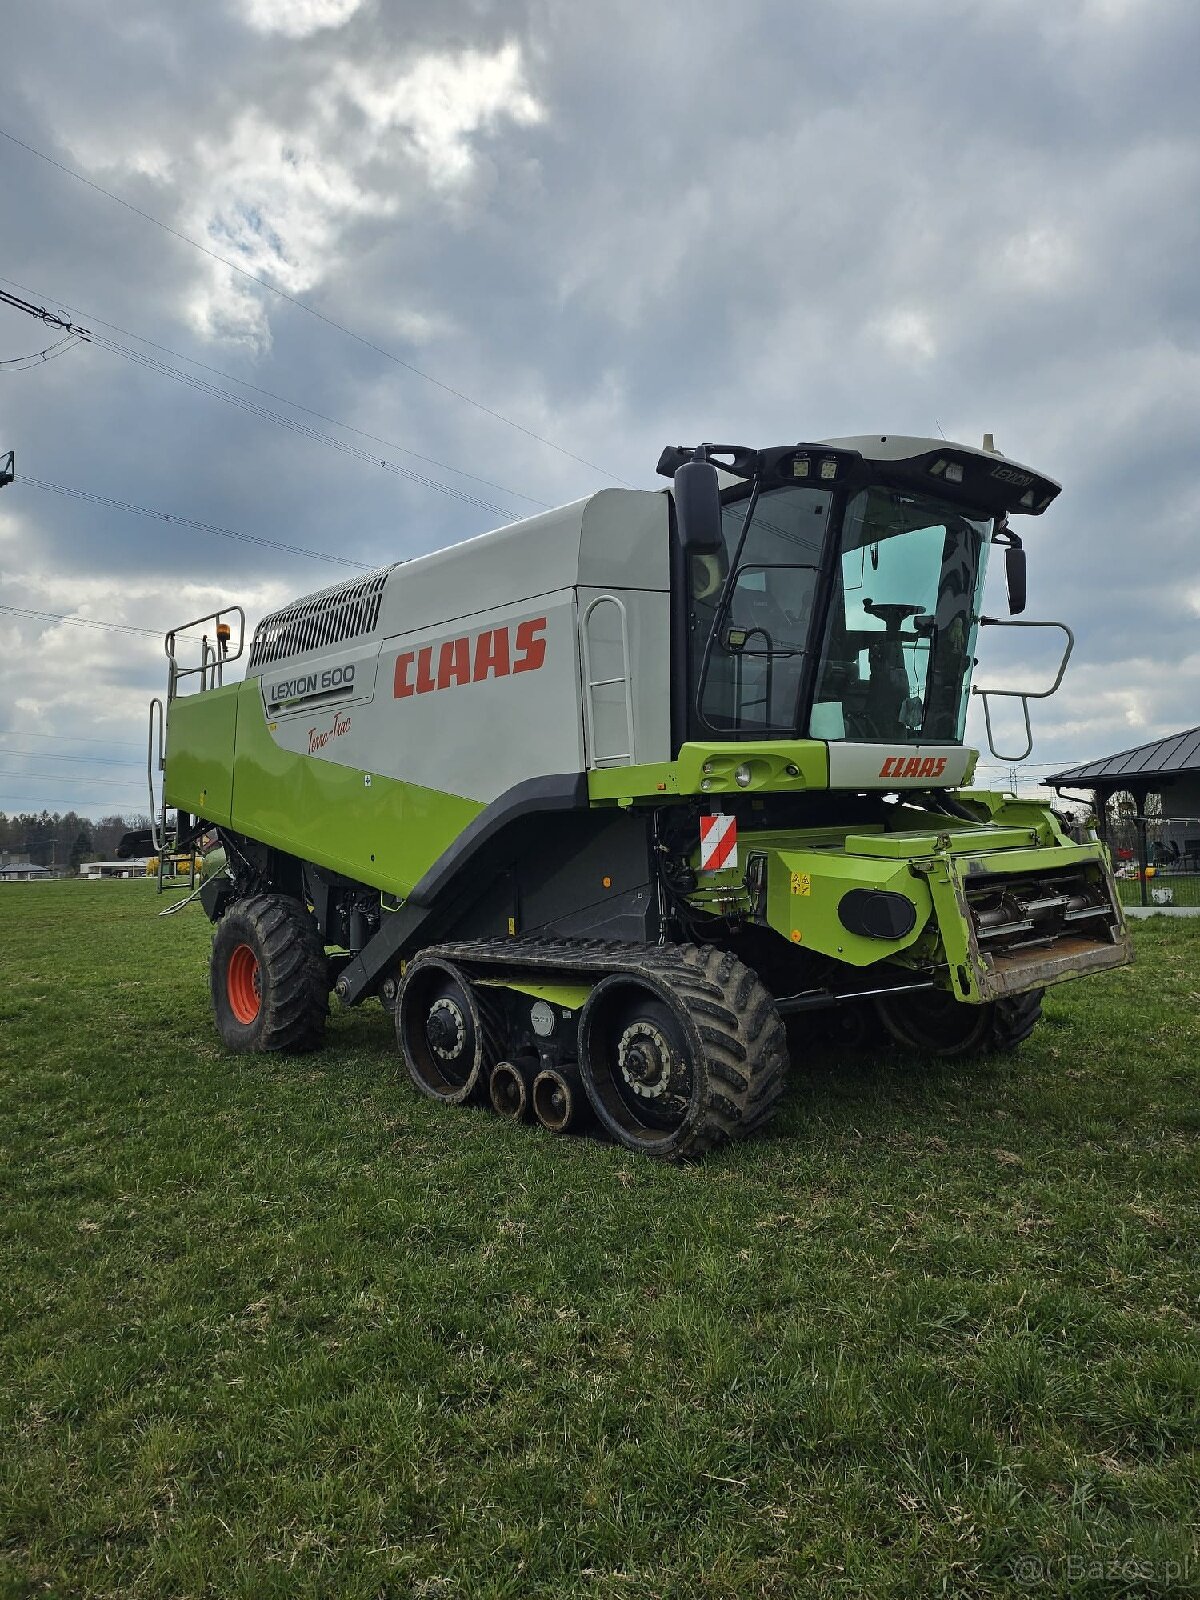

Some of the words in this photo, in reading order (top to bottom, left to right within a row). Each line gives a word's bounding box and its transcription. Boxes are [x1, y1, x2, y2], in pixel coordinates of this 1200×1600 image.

[393, 617, 547, 699] CLAAS
[271, 674, 318, 701] LEXION
[321, 664, 355, 689] 600
[879, 757, 948, 777] CLAAS
